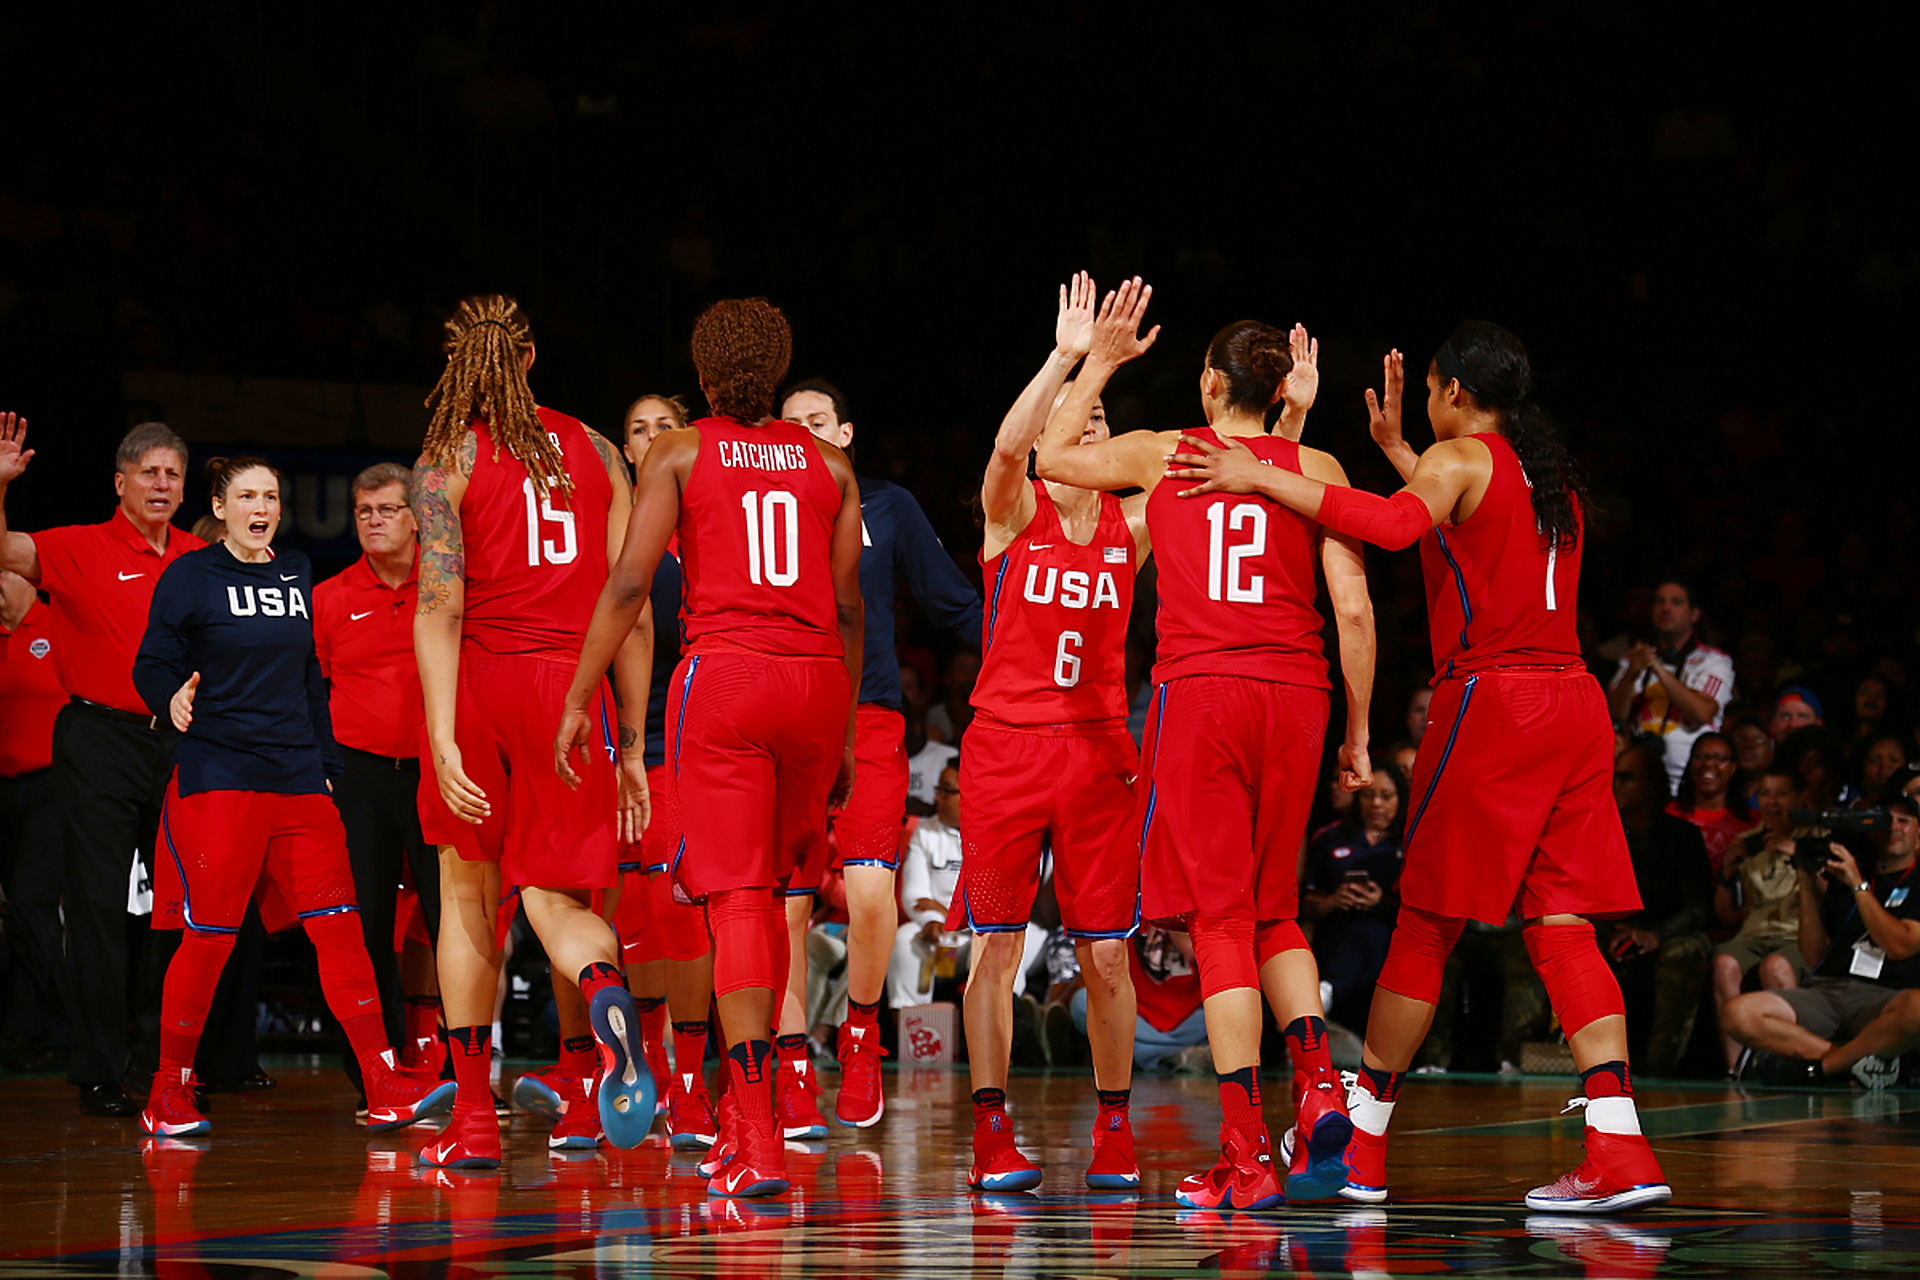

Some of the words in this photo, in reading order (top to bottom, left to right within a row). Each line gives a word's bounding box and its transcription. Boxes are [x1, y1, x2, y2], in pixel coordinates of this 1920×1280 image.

[718, 440, 807, 471] CATCHINGS
[523, 473, 578, 566] 15
[741, 490, 799, 587] 10
[1206, 501, 1268, 603] 12
[226, 584, 310, 620] USA
[1023, 564, 1120, 609] USA
[1053, 630, 1083, 687] 6
